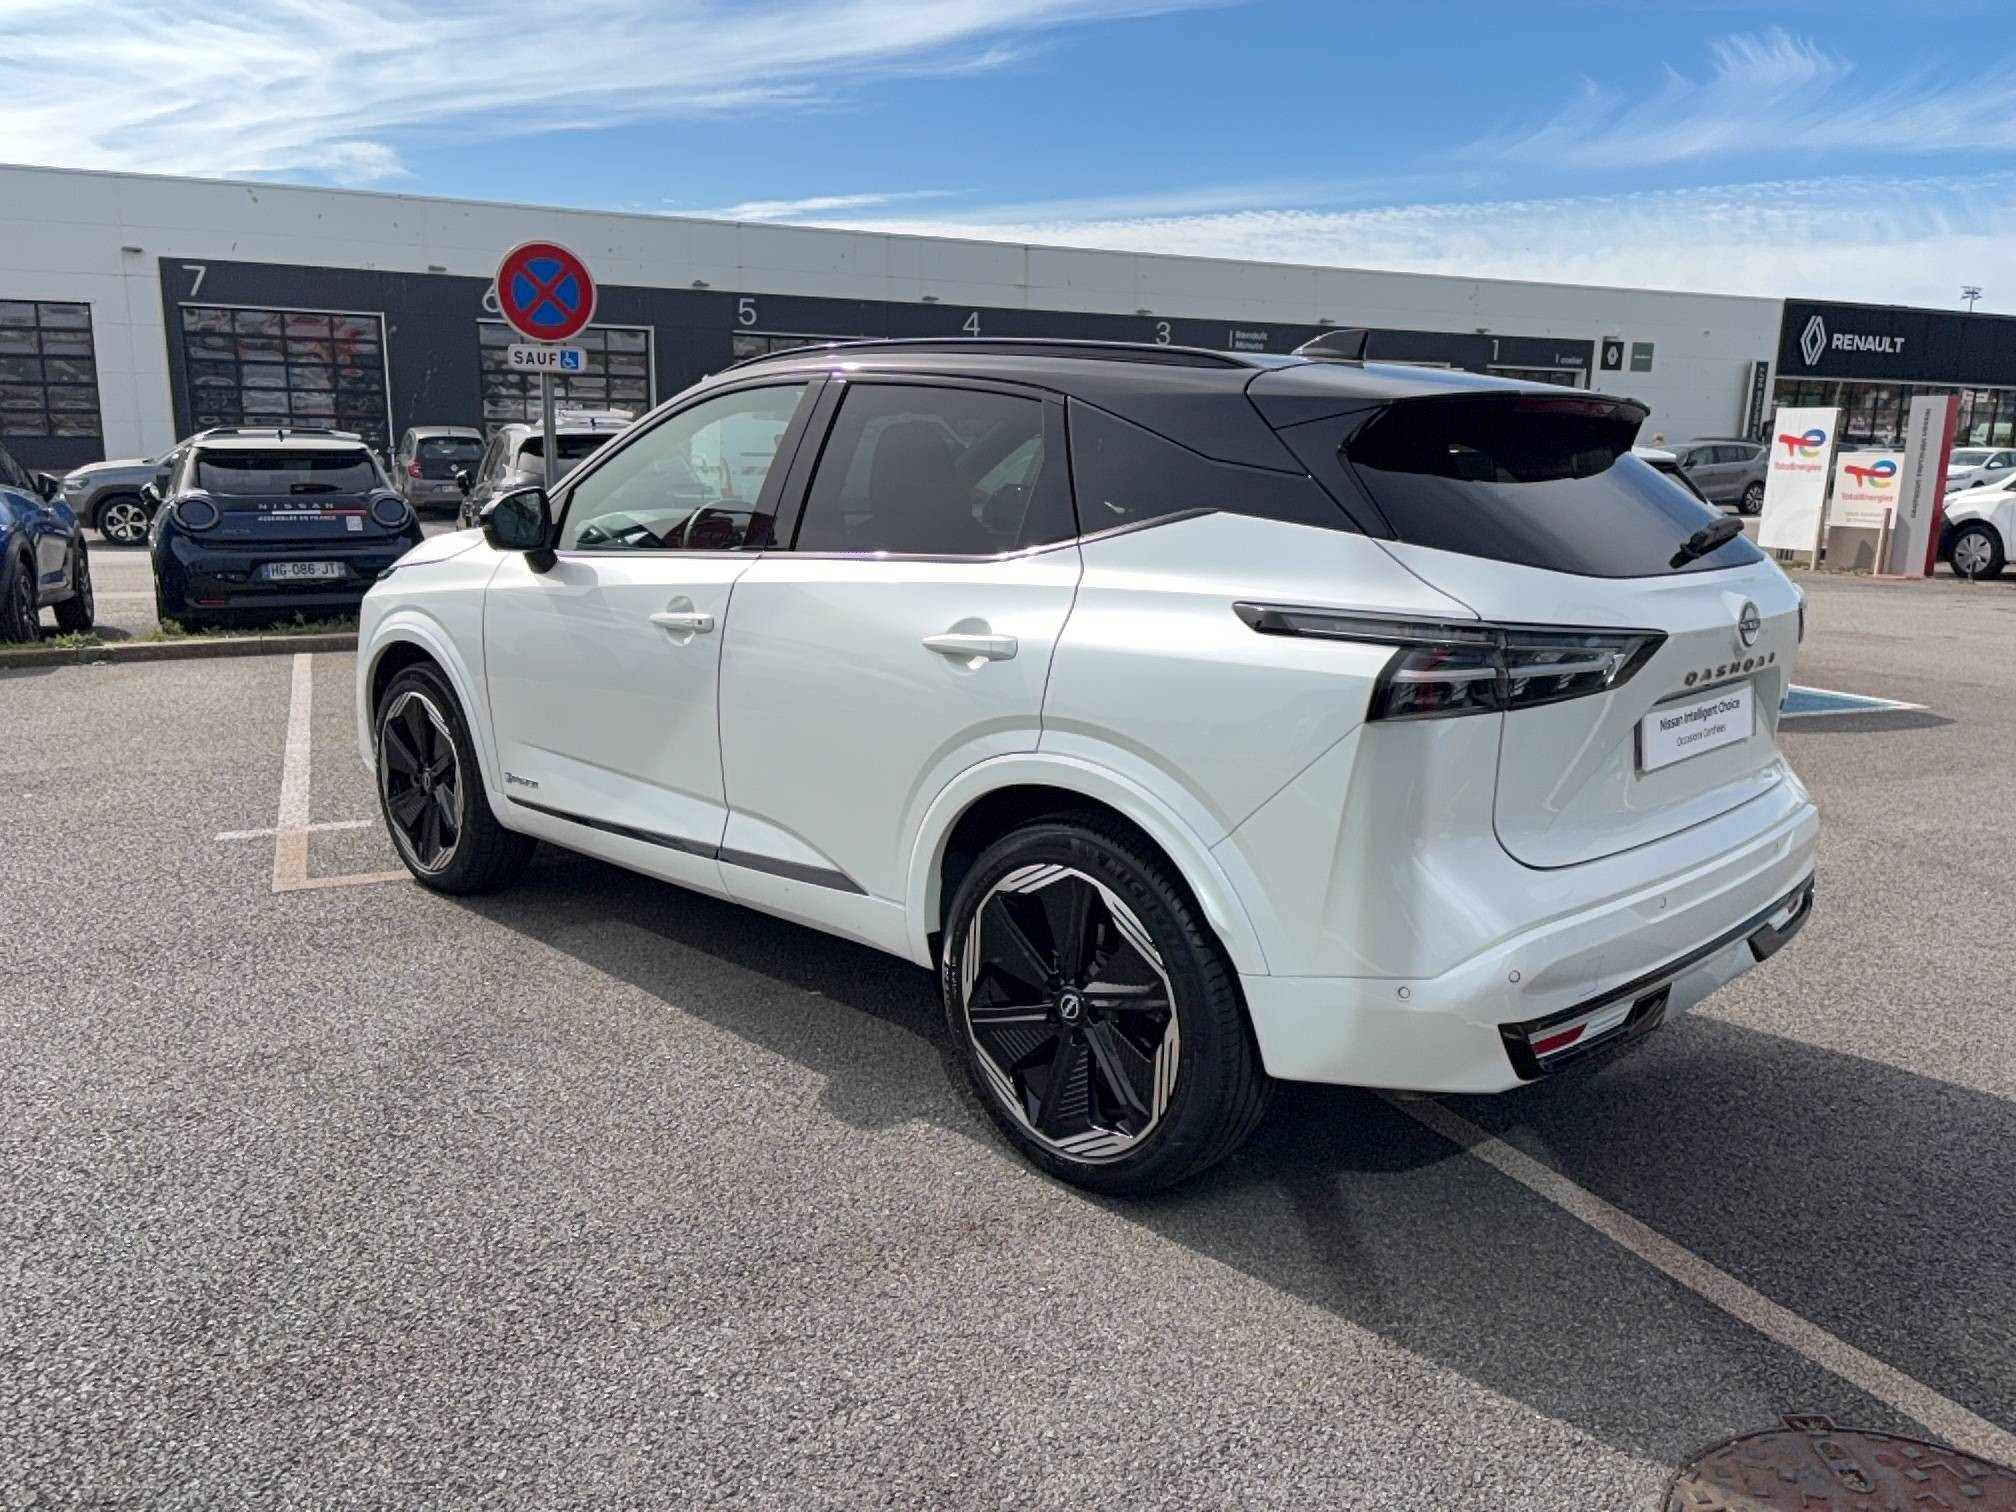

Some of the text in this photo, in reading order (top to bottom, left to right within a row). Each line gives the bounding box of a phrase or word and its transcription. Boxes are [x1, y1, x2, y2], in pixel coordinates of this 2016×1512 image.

[181, 265, 208, 297] 7
[737, 297, 757, 325] 5
[962, 311, 981, 337] 4
[1155, 321, 1171, 347] 3
[1831, 333, 1905, 353] RENAULT
[513, 351, 558, 366] SAUF
[1491, 339, 1500, 361] 1
[1774, 462, 1823, 473] TotalEnergies
[1841, 492, 1894, 504] TotalEnergies
[1684, 651, 1776, 687] QASHQAI
[1660, 698, 1741, 733] Nissan Intelligent Choice
